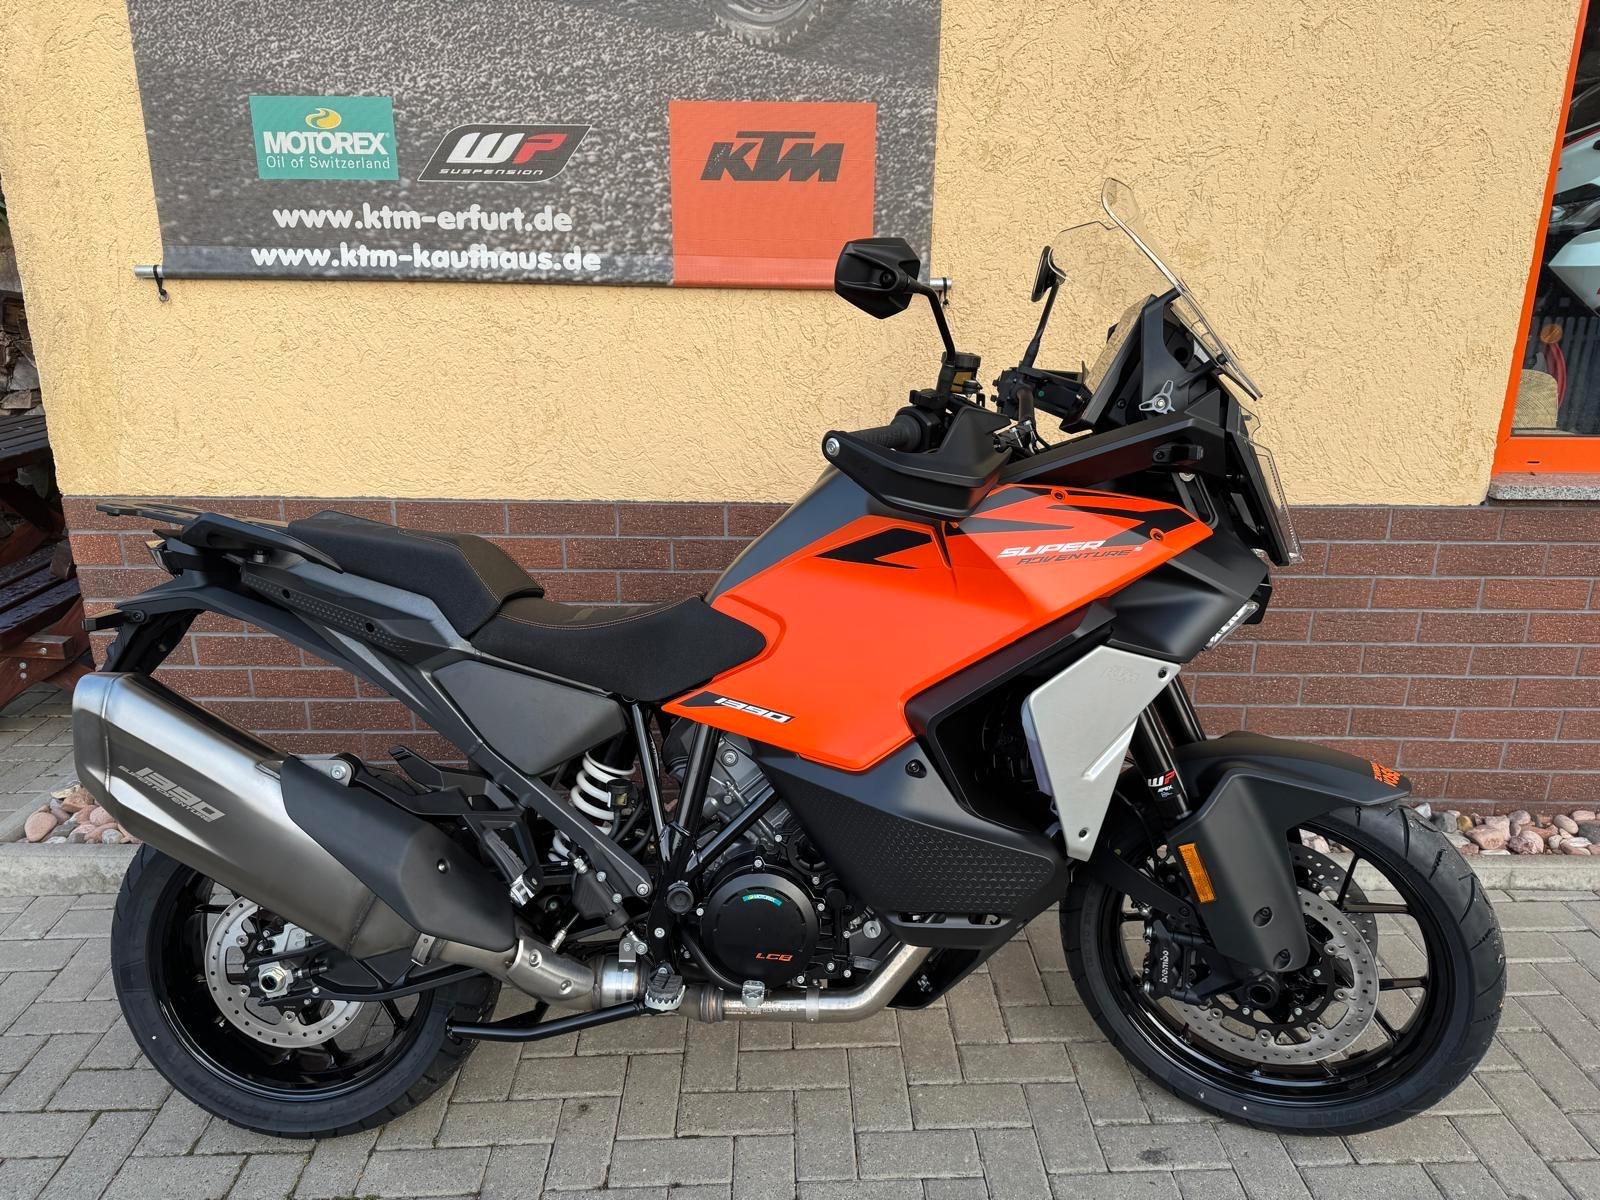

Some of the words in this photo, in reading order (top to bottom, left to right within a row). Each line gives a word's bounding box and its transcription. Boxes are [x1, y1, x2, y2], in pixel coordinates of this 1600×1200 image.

[263, 131, 389, 155] MOTOREX
[446, 132, 568, 164] WP
[266, 155, 285, 168] Oil
[290, 156, 304, 168] of
[309, 156, 390, 169] Switzerland
[701, 131, 844, 182] KTM
[439, 168, 543, 176] SUSPENSION
[272, 202, 573, 232] www.ktm-erfurt.de
[250, 242, 601, 272] www.ktm-kaufhaus.de
[997, 540, 1106, 558] SUPER
[1016, 549, 1132, 566] ADVENTURE
[1147, 770, 1176, 788] WP
[1160, 950, 1169, 984] brembo
